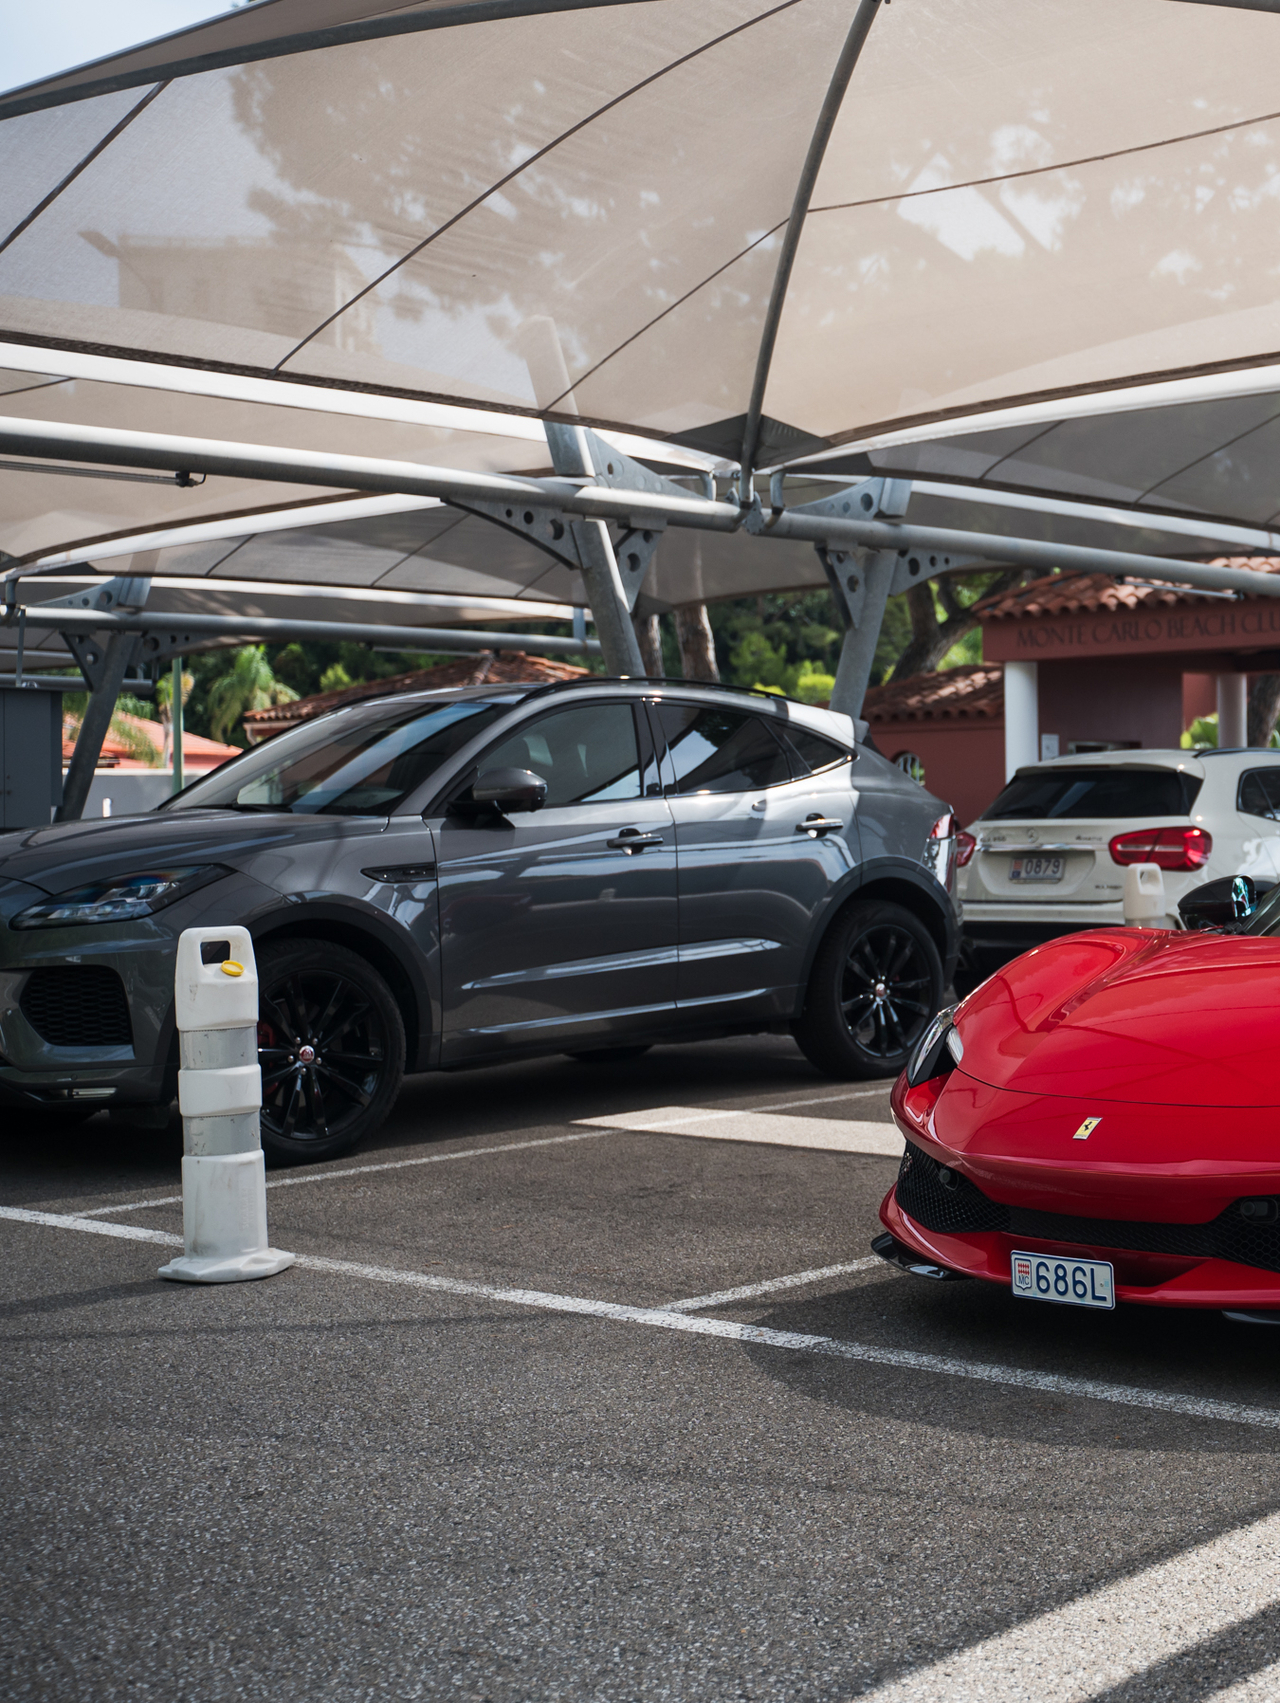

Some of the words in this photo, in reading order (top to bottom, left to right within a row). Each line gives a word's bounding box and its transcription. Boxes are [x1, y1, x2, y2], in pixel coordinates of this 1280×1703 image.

[1016, 623, 1087, 648] MONTE
[1091, 619, 1162, 643] CARLO
[1167, 613, 1236, 640] BEACH
[1024, 858, 1061, 875] 0879
[1036, 1261, 1107, 1302] 686L
